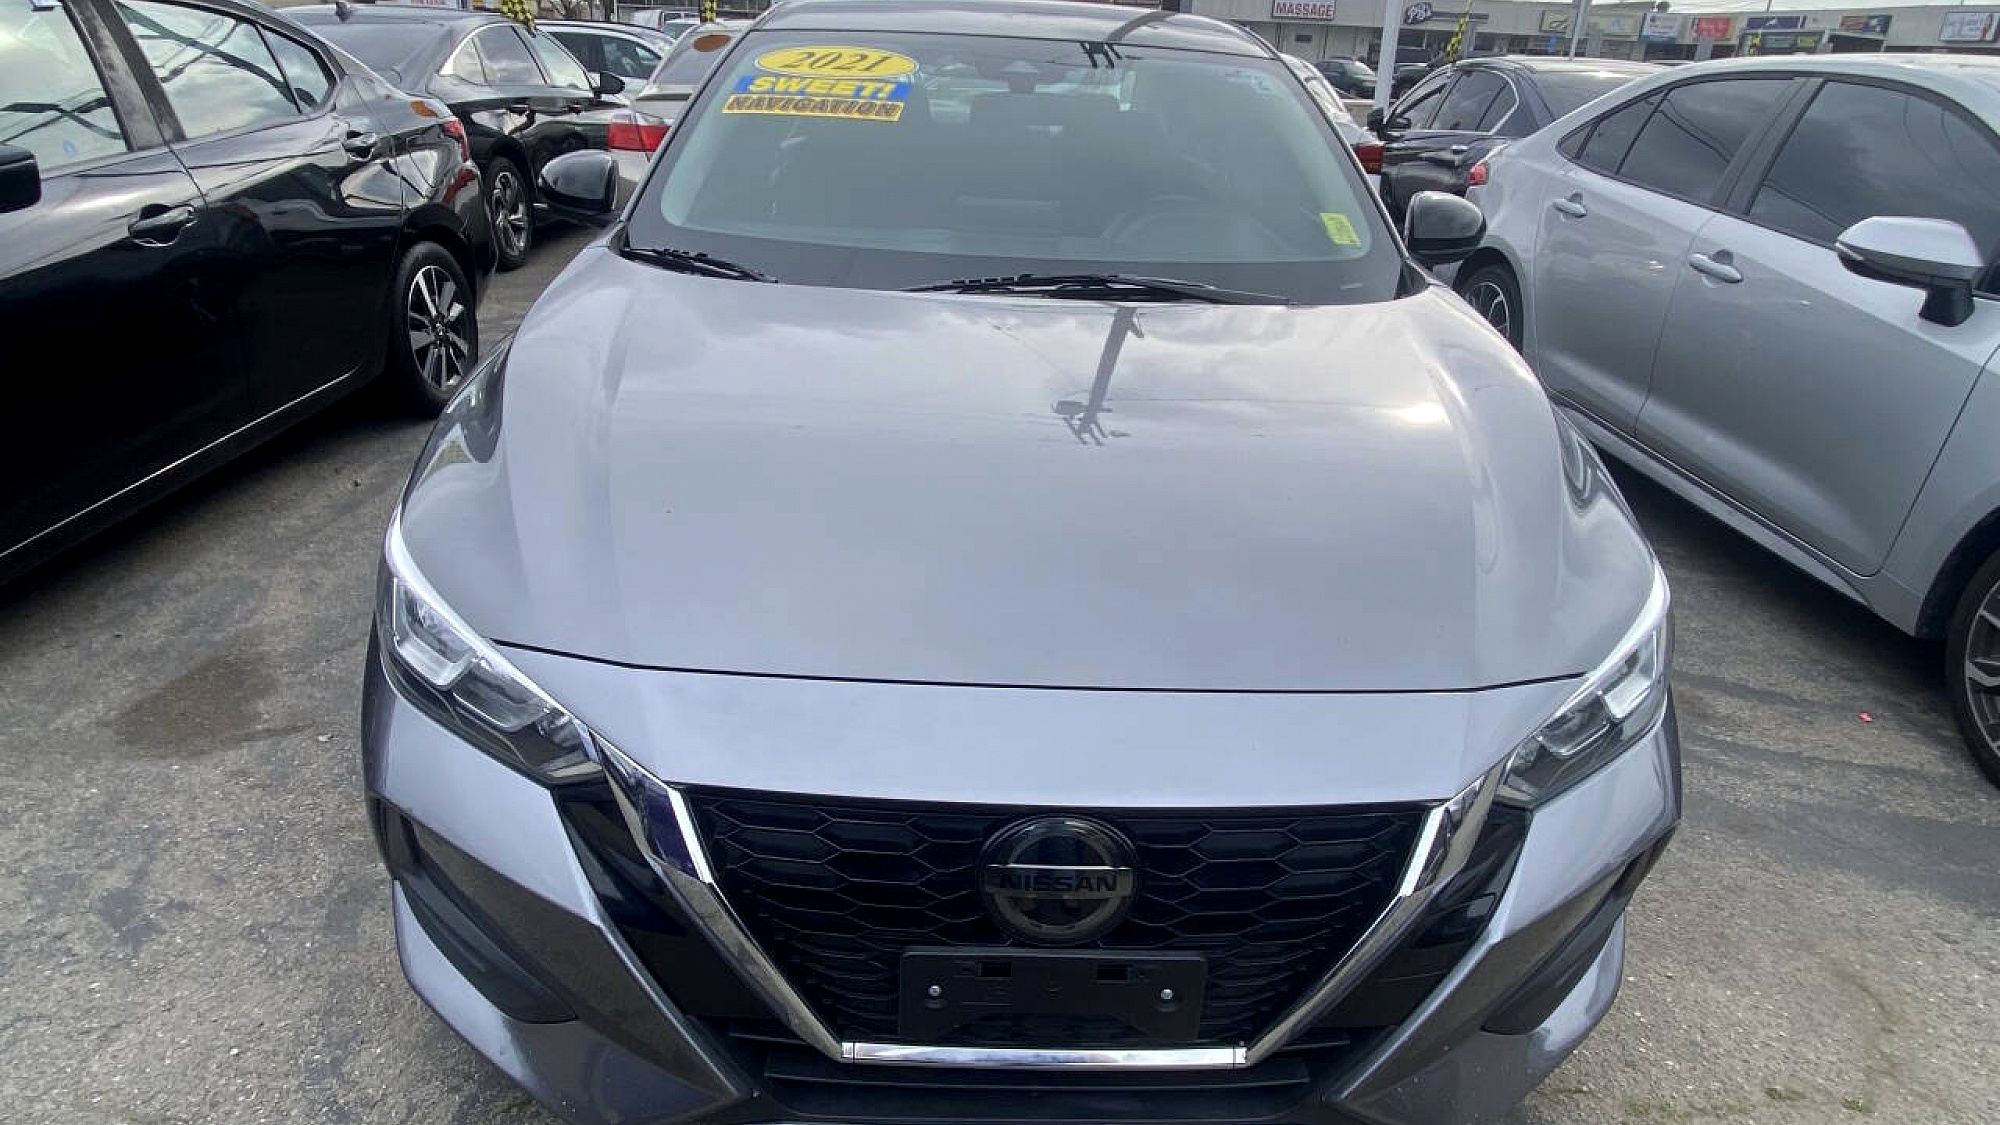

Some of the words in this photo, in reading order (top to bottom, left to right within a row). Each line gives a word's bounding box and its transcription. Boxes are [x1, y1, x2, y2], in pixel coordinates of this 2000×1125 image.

[1276, 2, 1334, 17] MASSAGE
[781, 51, 891, 72] 2021
[748, 75, 896, 98] SWEET!
[725, 96, 901, 118] NAVIGATION
[1000, 873, 1118, 892] NISSAN
